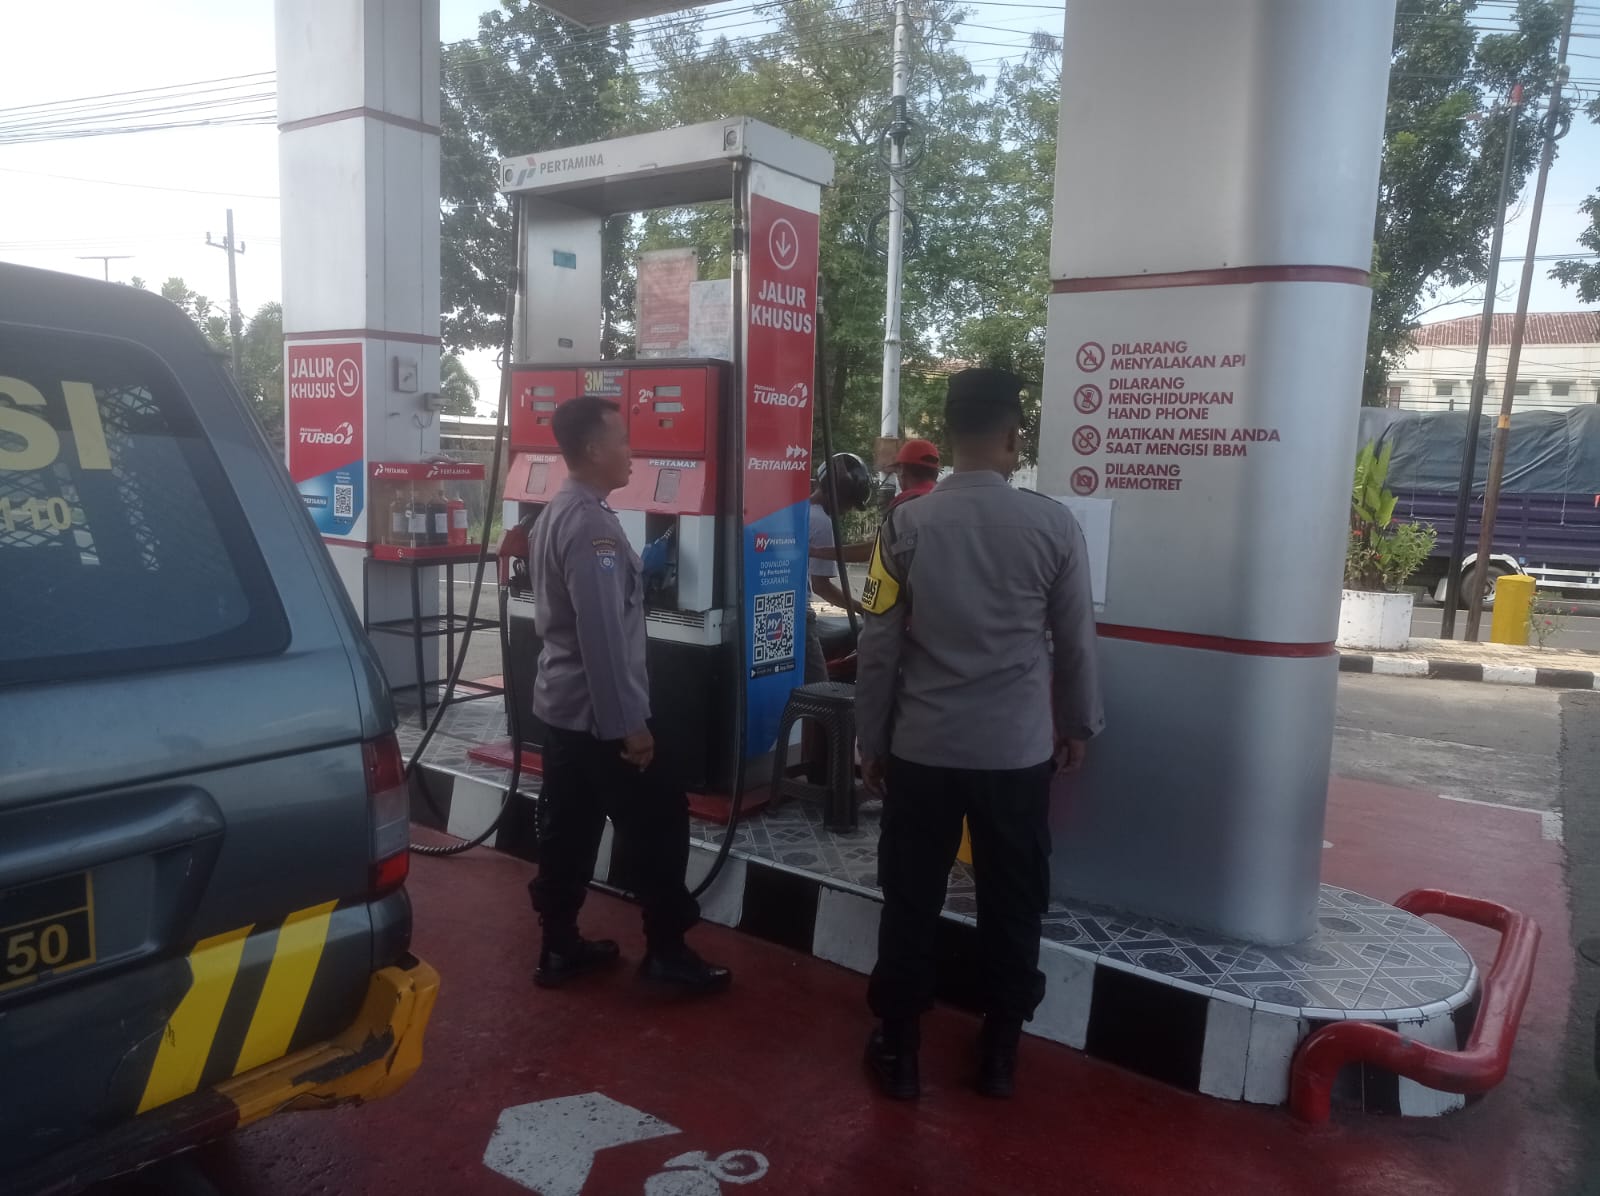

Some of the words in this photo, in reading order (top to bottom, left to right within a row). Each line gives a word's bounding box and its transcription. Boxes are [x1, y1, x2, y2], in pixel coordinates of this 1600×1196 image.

[540, 154, 604, 174] PERTAMINA
[758, 280, 806, 308] JALUR
[751, 304, 811, 334] KHUSUS
[1111, 341, 1188, 355] DILARANG
[291, 357, 335, 378] JALUR
[1110, 355, 1216, 370] MENYALAKAN
[1220, 354, 1246, 368] API
[584, 371, 604, 392] 3M
[1109, 377, 1185, 390] DILARANG
[291, 382, 336, 399] KHUSUS
[753, 390, 799, 407] TURBO
[1108, 391, 1233, 405] MENGHIDUPKAN
[1107, 408, 1151, 420] HAND
[1155, 408, 1209, 420] PHONE
[299, 432, 345, 444] TURBO
[1106, 428, 1175, 441] MATIKAN
[1178, 428, 1226, 441] MESIN
[1230, 429, 1280, 442] ANDA
[1105, 442, 1142, 455] SAAT
[1145, 443, 1208, 456] MENGISI
[1212, 444, 1247, 457] BBM
[649, 459, 697, 468] PERTAMAX
[748, 457, 808, 471] PERTAMAX
[1105, 463, 1180, 477] DILARANG
[1104, 477, 1183, 491] MEMOTRET
[6, 924, 69, 975] 50
